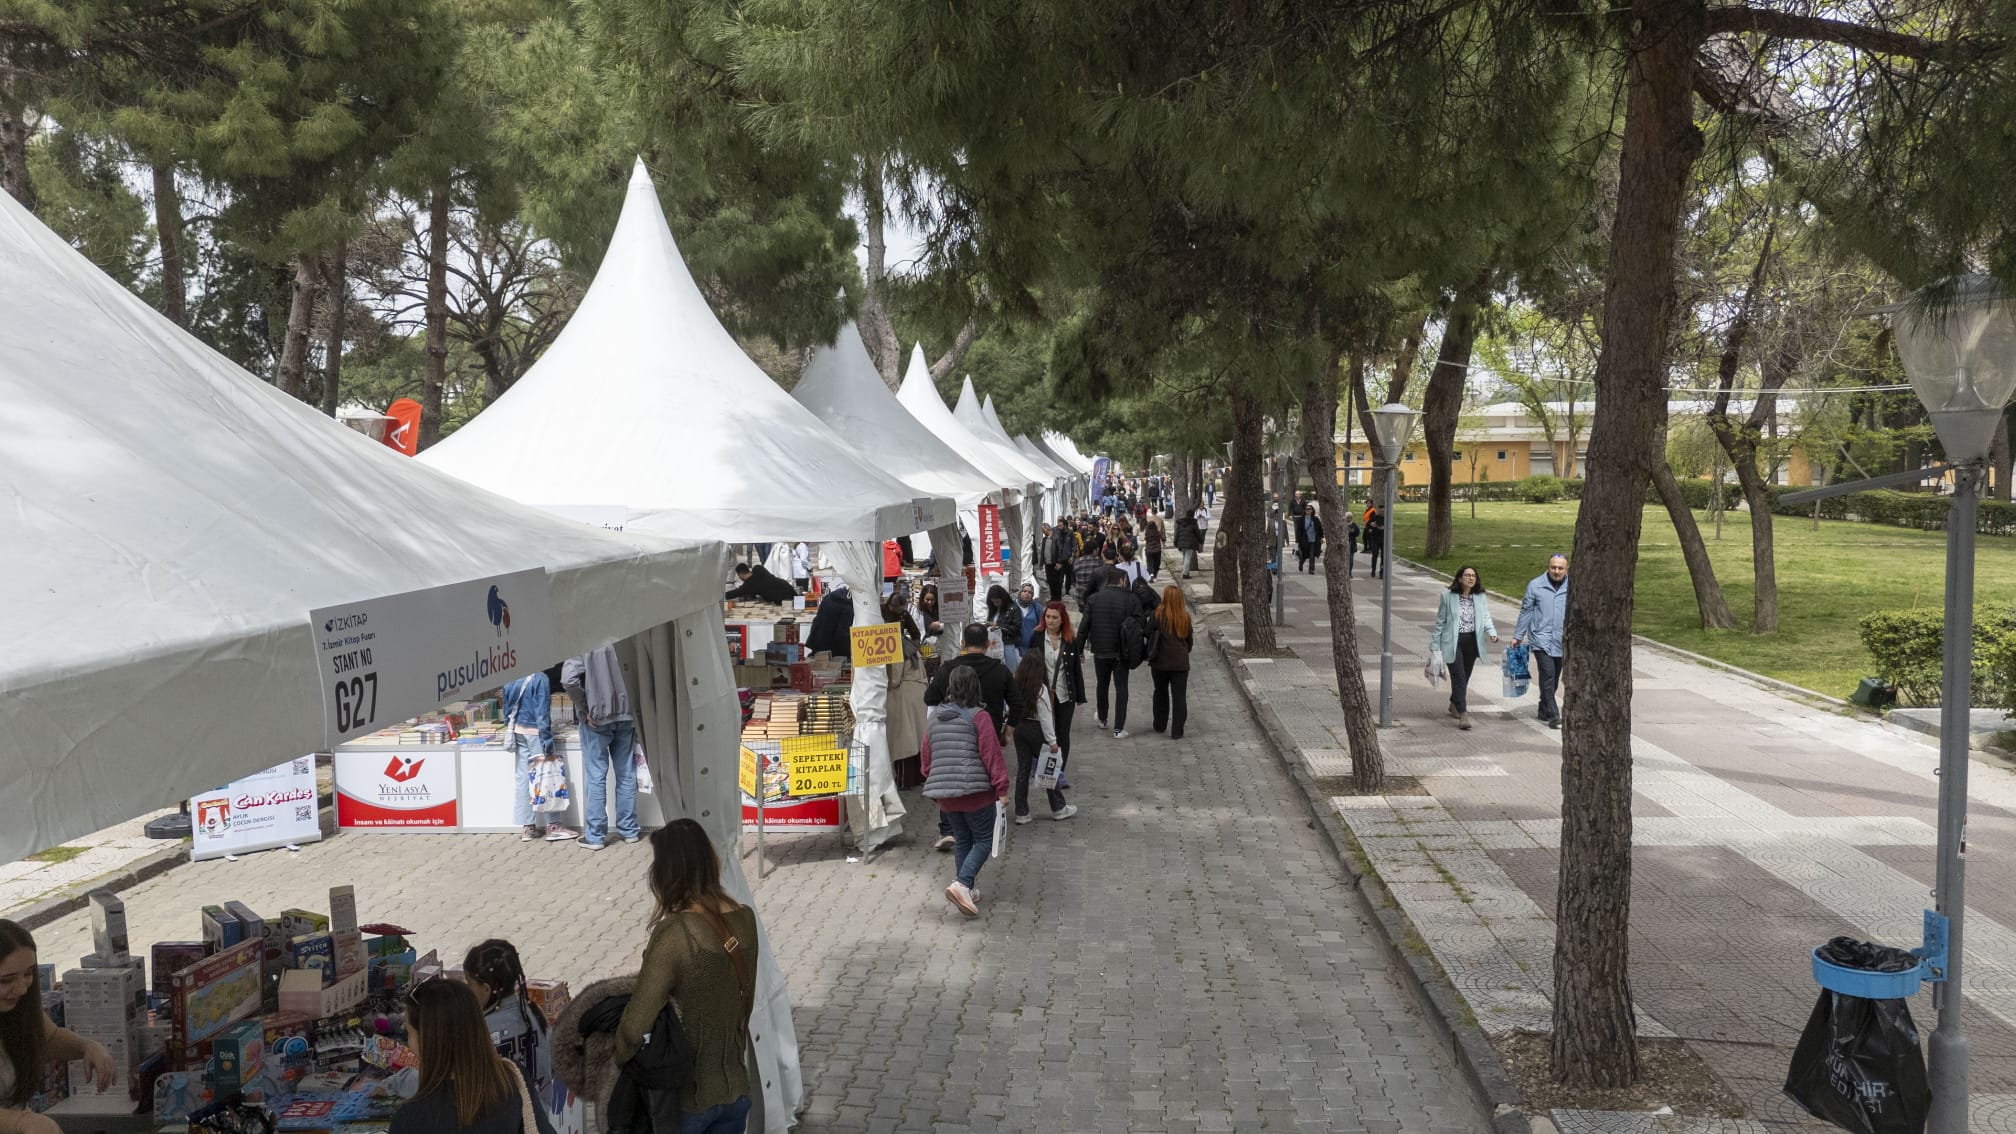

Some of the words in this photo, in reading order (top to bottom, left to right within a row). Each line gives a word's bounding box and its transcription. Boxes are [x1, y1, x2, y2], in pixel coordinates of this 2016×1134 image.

[857, 635, 897, 657] %20
[333, 651, 359, 674] STANT
[360, 647, 373, 666] NO
[437, 641, 516, 702] pusulakids
[335, 671, 378, 734] G27
[793, 752, 844, 763] SEPETTEKİ
[795, 764, 842, 774] KİTAPLAR
[795, 779, 829, 791] 20.00
